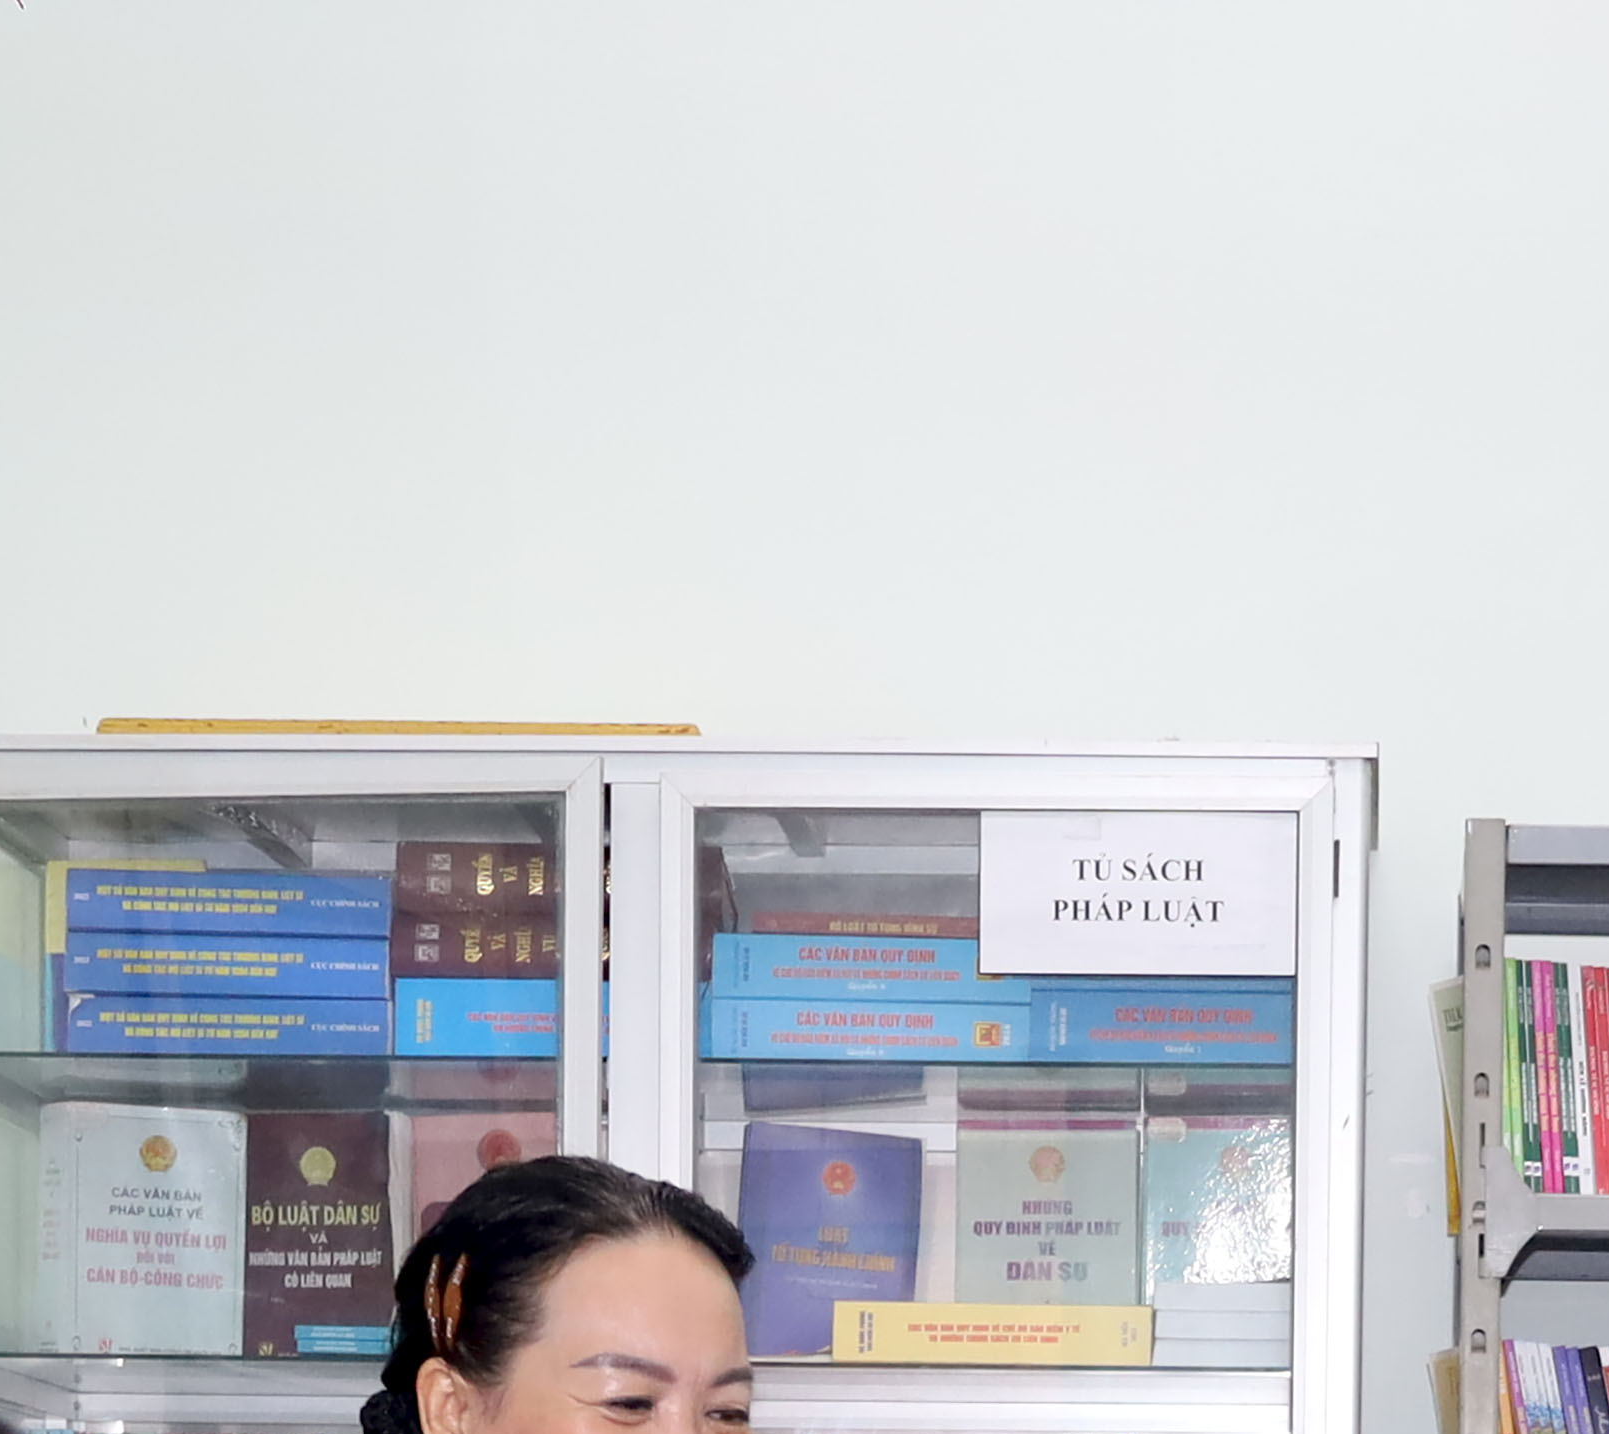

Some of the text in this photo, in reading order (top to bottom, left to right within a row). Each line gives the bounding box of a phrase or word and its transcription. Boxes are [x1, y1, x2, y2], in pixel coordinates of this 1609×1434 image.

[1072, 852, 1204, 881] TỦ SÁCH
[1053, 892, 1225, 928] PHÁP LUẬT
[252, 1201, 381, 1231] BỘ LUẬT DÂN SỰ
[309, 1229, 328, 1244] VÀ
